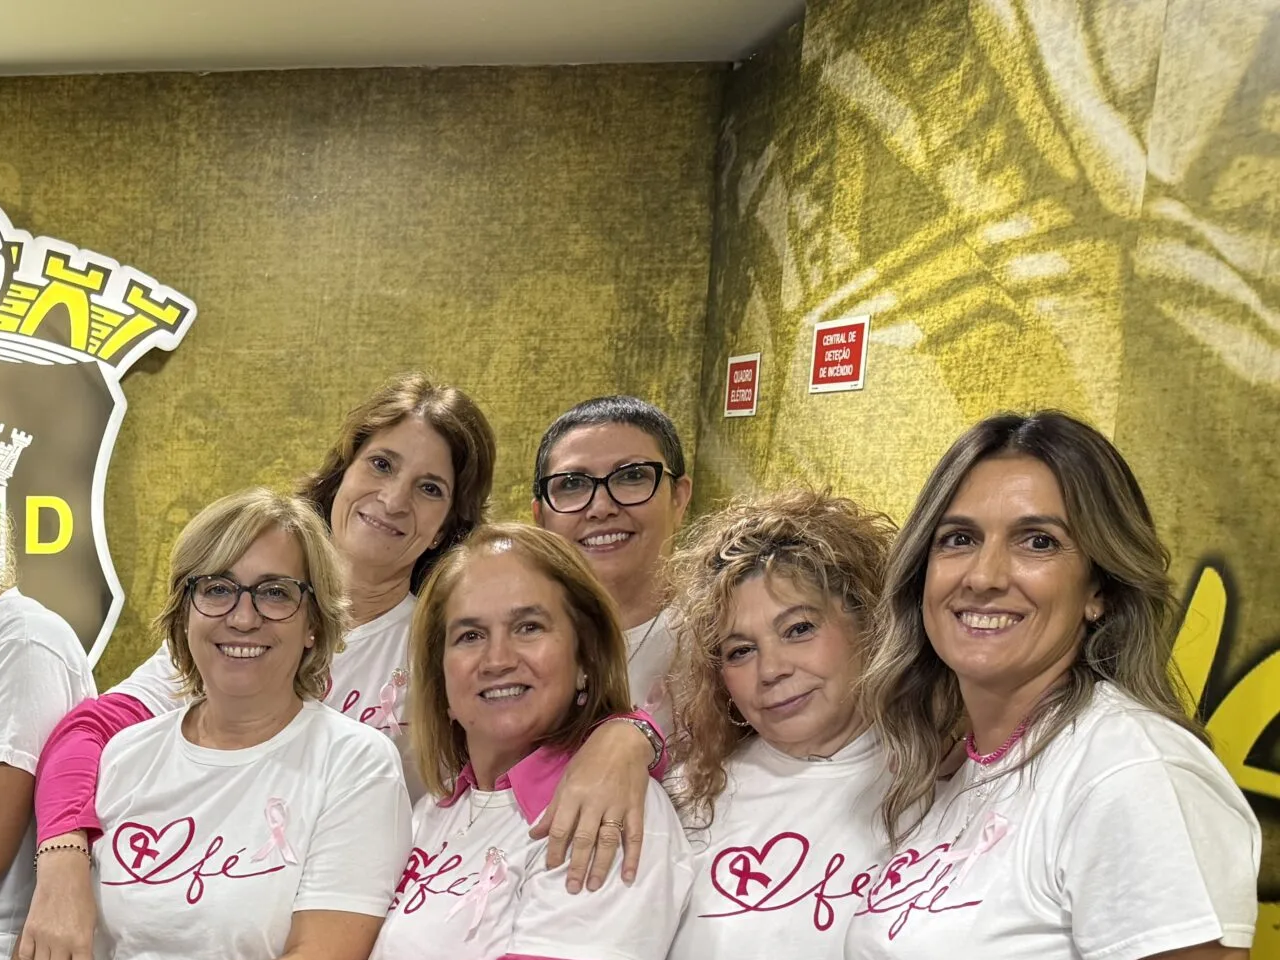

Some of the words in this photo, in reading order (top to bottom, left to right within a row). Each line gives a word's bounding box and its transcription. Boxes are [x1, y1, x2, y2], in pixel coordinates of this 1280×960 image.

[822, 333, 846, 346] CENTRAL
[848, 331, 857, 343] DE
[824, 347, 851, 363] DETEÇÃO
[733, 369, 753, 384] QUADRO
[819, 366, 827, 378] DE
[827, 363, 853, 378] INCÊNDIO
[730, 387, 752, 402] ELÉTRICO
[25, 495, 73, 554] D
